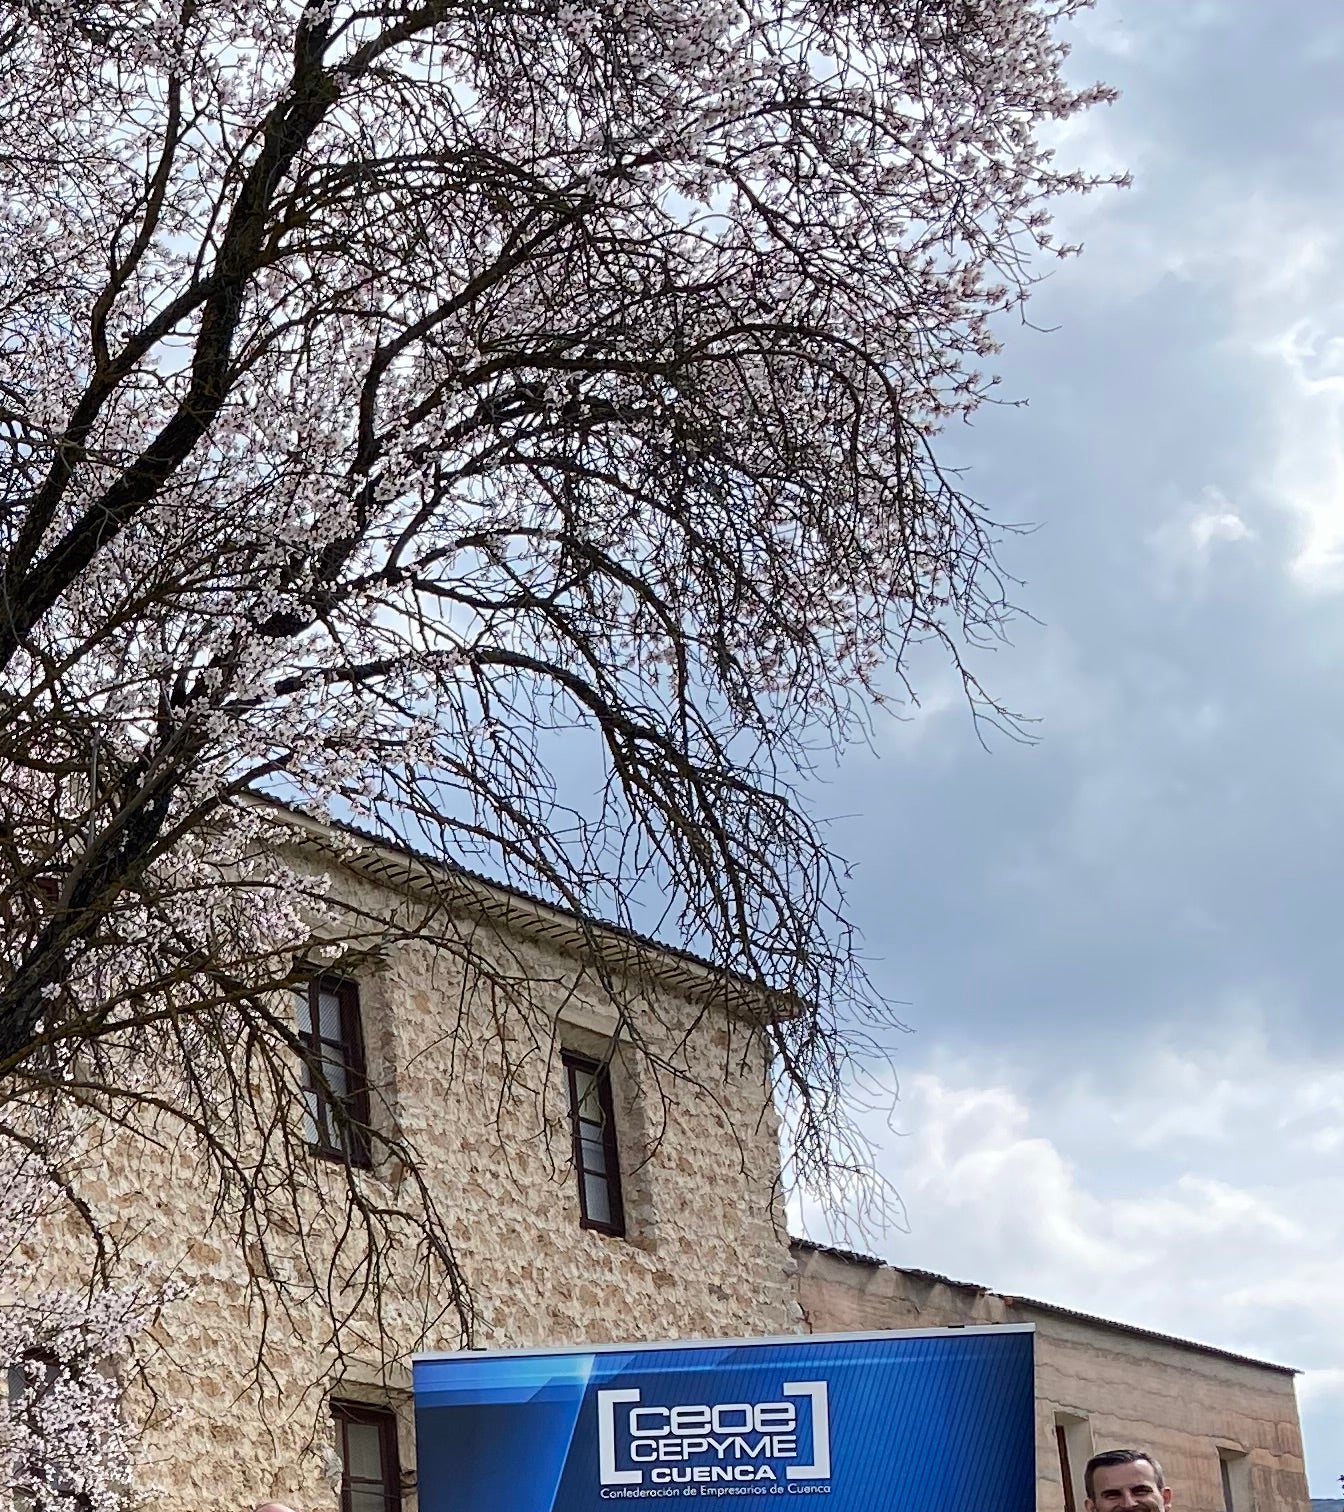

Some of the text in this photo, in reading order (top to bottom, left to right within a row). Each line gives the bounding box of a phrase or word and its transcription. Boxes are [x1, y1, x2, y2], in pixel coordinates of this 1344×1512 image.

[630, 1435, 797, 1462] CEPYME
[651, 1465, 776, 1483] CUENCA
[600, 1483, 831, 1499] Confederación de Empresarios de Cuenca
